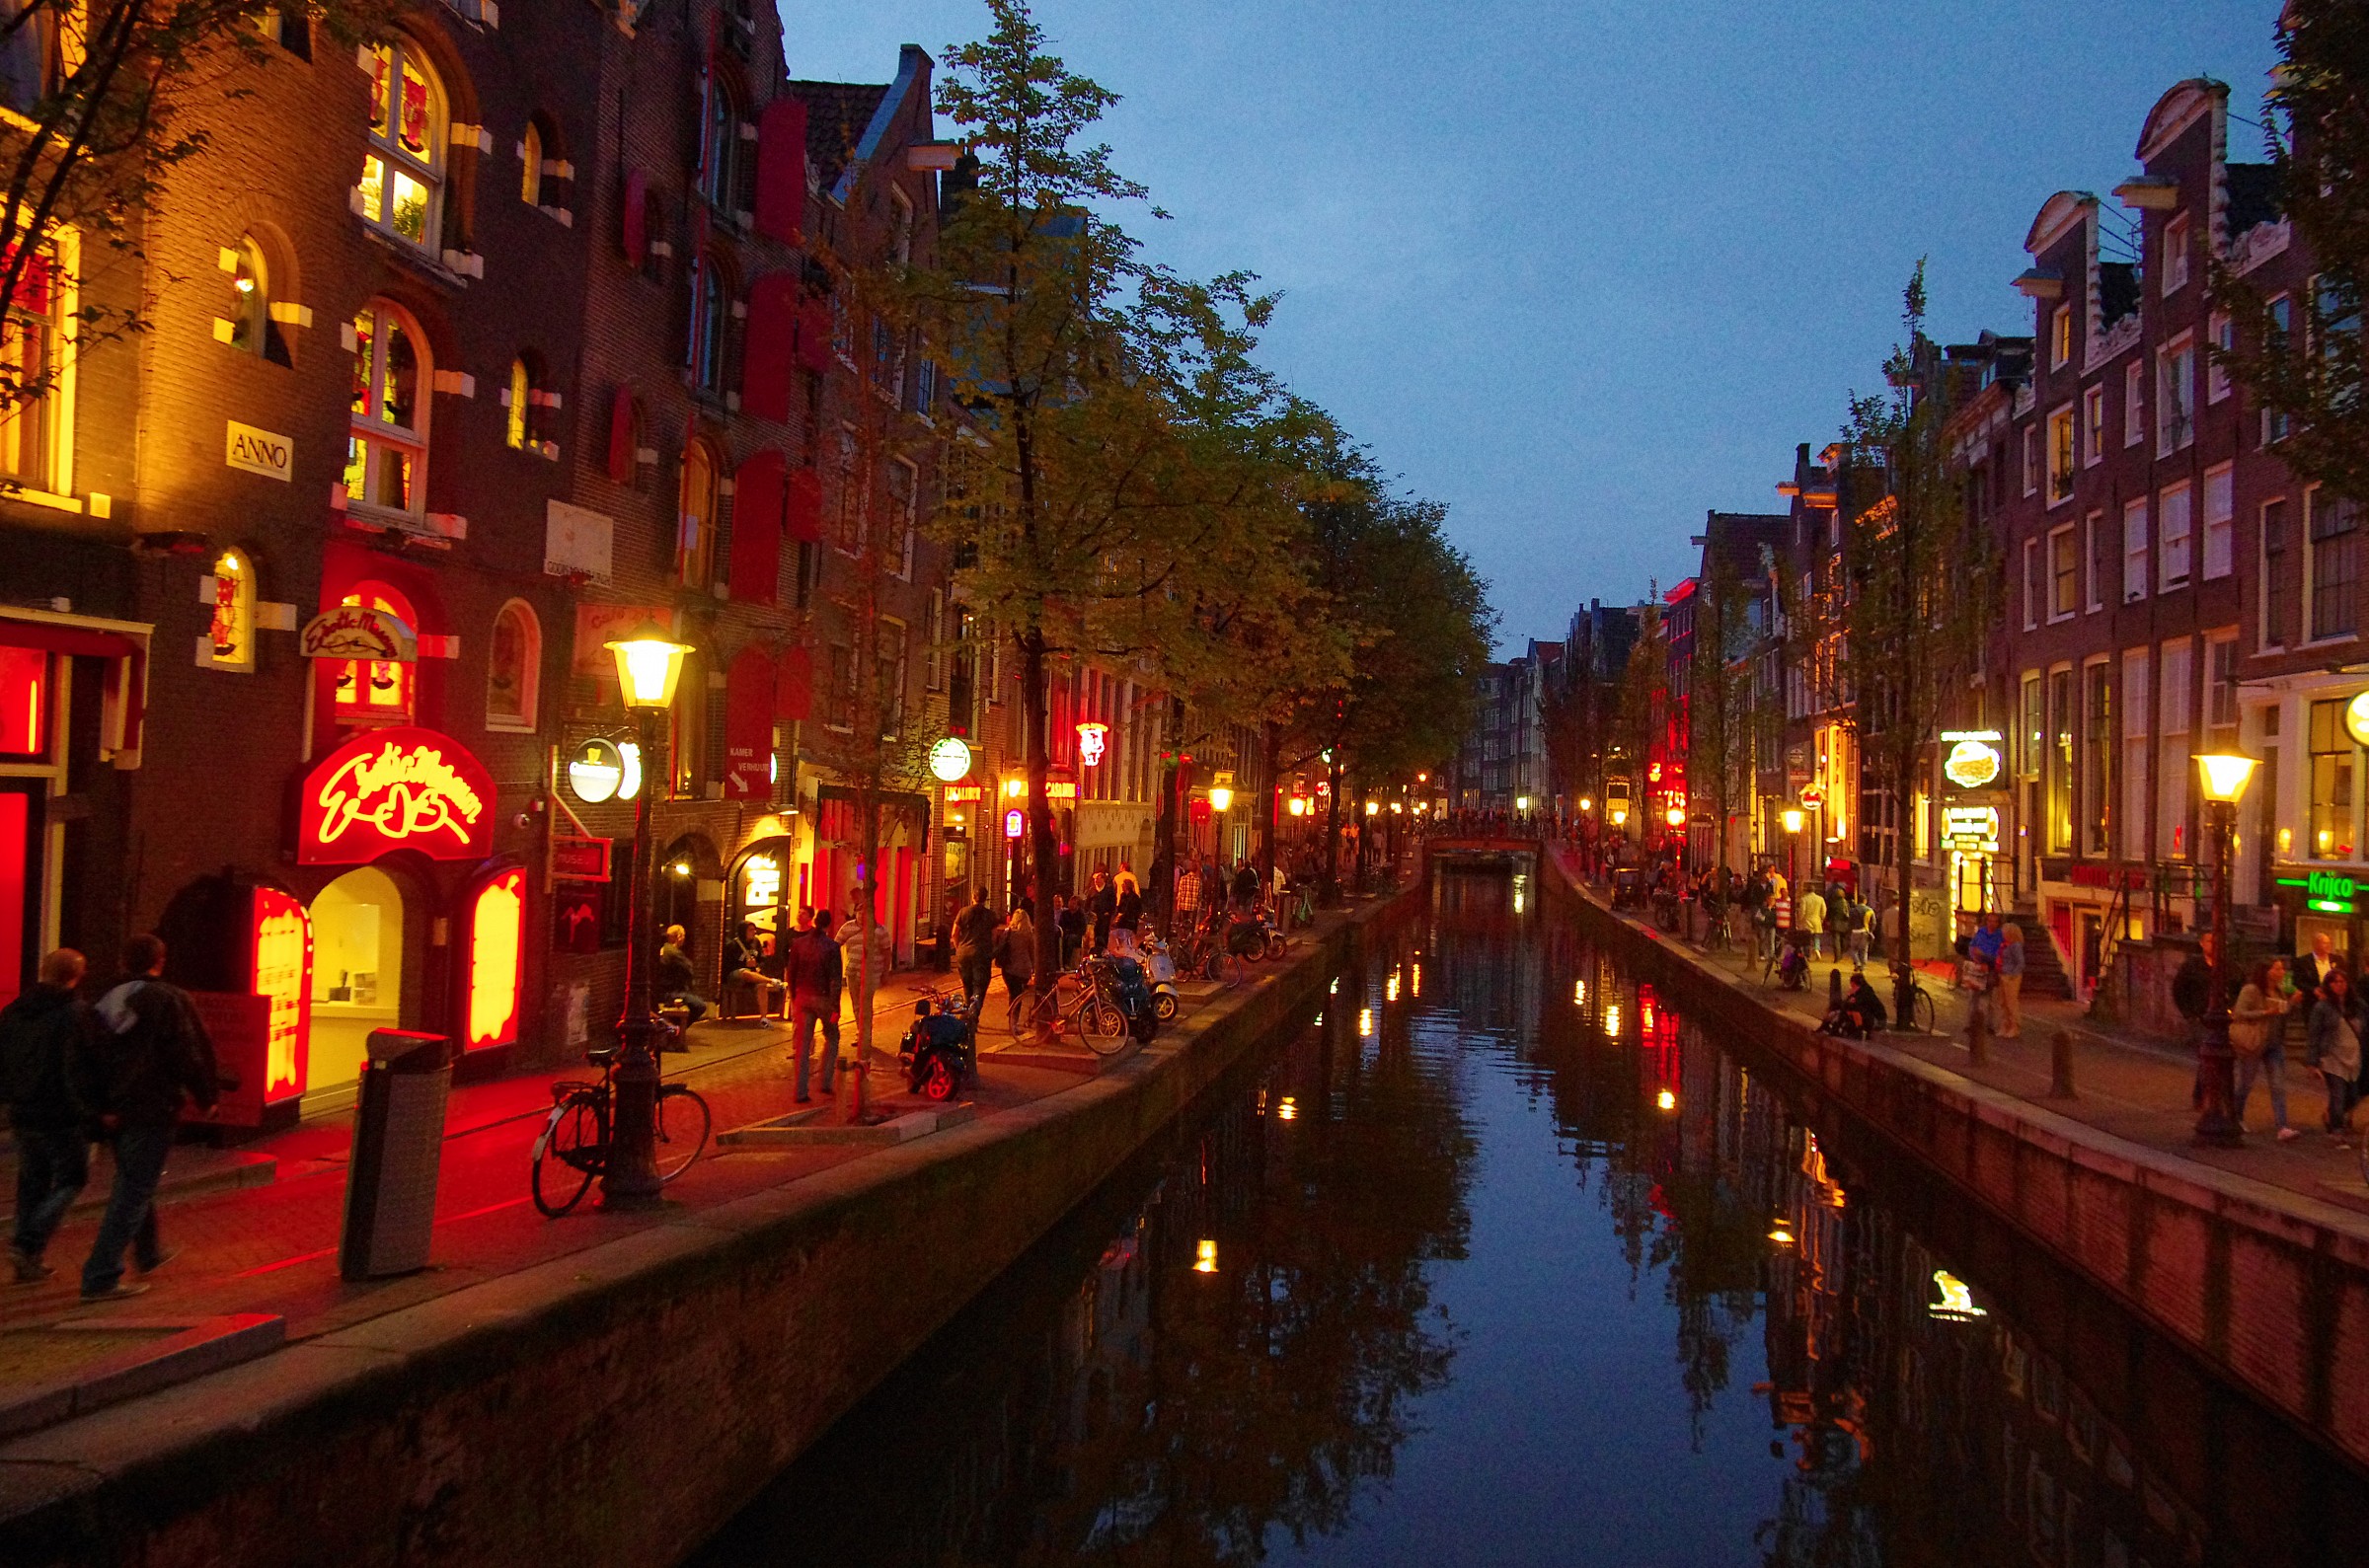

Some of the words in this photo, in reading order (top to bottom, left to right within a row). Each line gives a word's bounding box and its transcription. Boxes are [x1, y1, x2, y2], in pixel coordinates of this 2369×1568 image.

[232, 433, 287, 469] ANNO
[729, 747, 753, 757] KAMER
[557, 854, 598, 865] MUSE
[2308, 870, 2353, 901] Krijco
